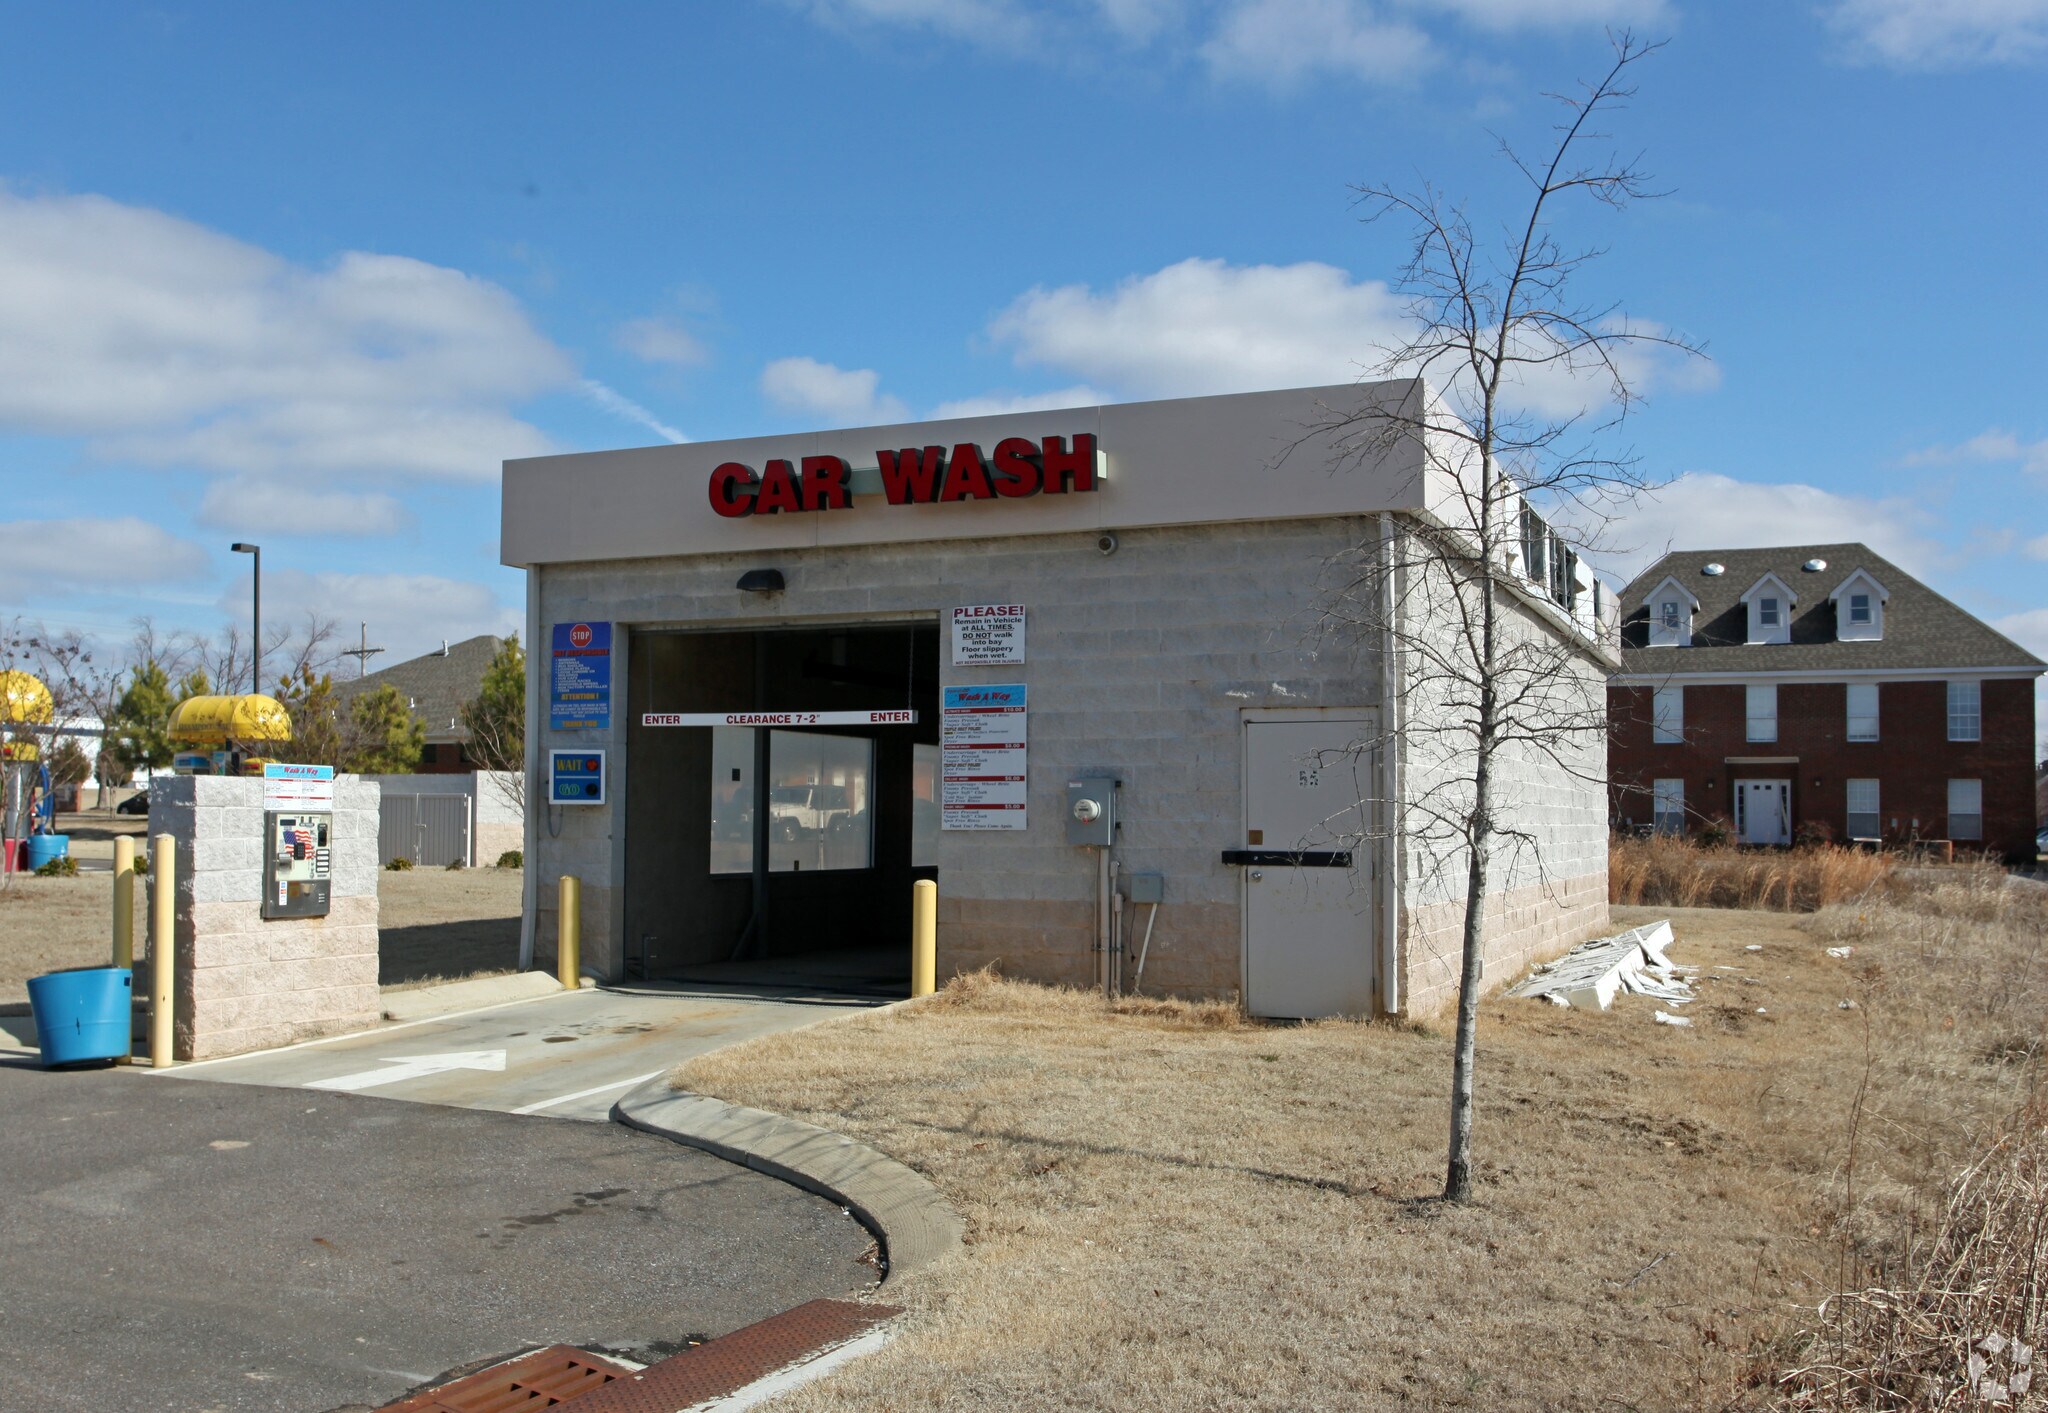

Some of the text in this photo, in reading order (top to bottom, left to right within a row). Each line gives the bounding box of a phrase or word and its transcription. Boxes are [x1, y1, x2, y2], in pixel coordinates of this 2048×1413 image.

[709, 432, 1098, 518] CAR WASH
[954, 606, 1024, 618] PLEASE!
[573, 632, 590, 640] STOP
[958, 692, 981, 702] Wash
[992, 692, 1010, 701] Way
[645, 715, 680, 724] ENTER
[726, 714, 790, 724] CLEARANCE
[870, 712, 910, 722] ENTER
[556, 760, 582, 770] WAIT
[558, 784, 580, 796] GO
